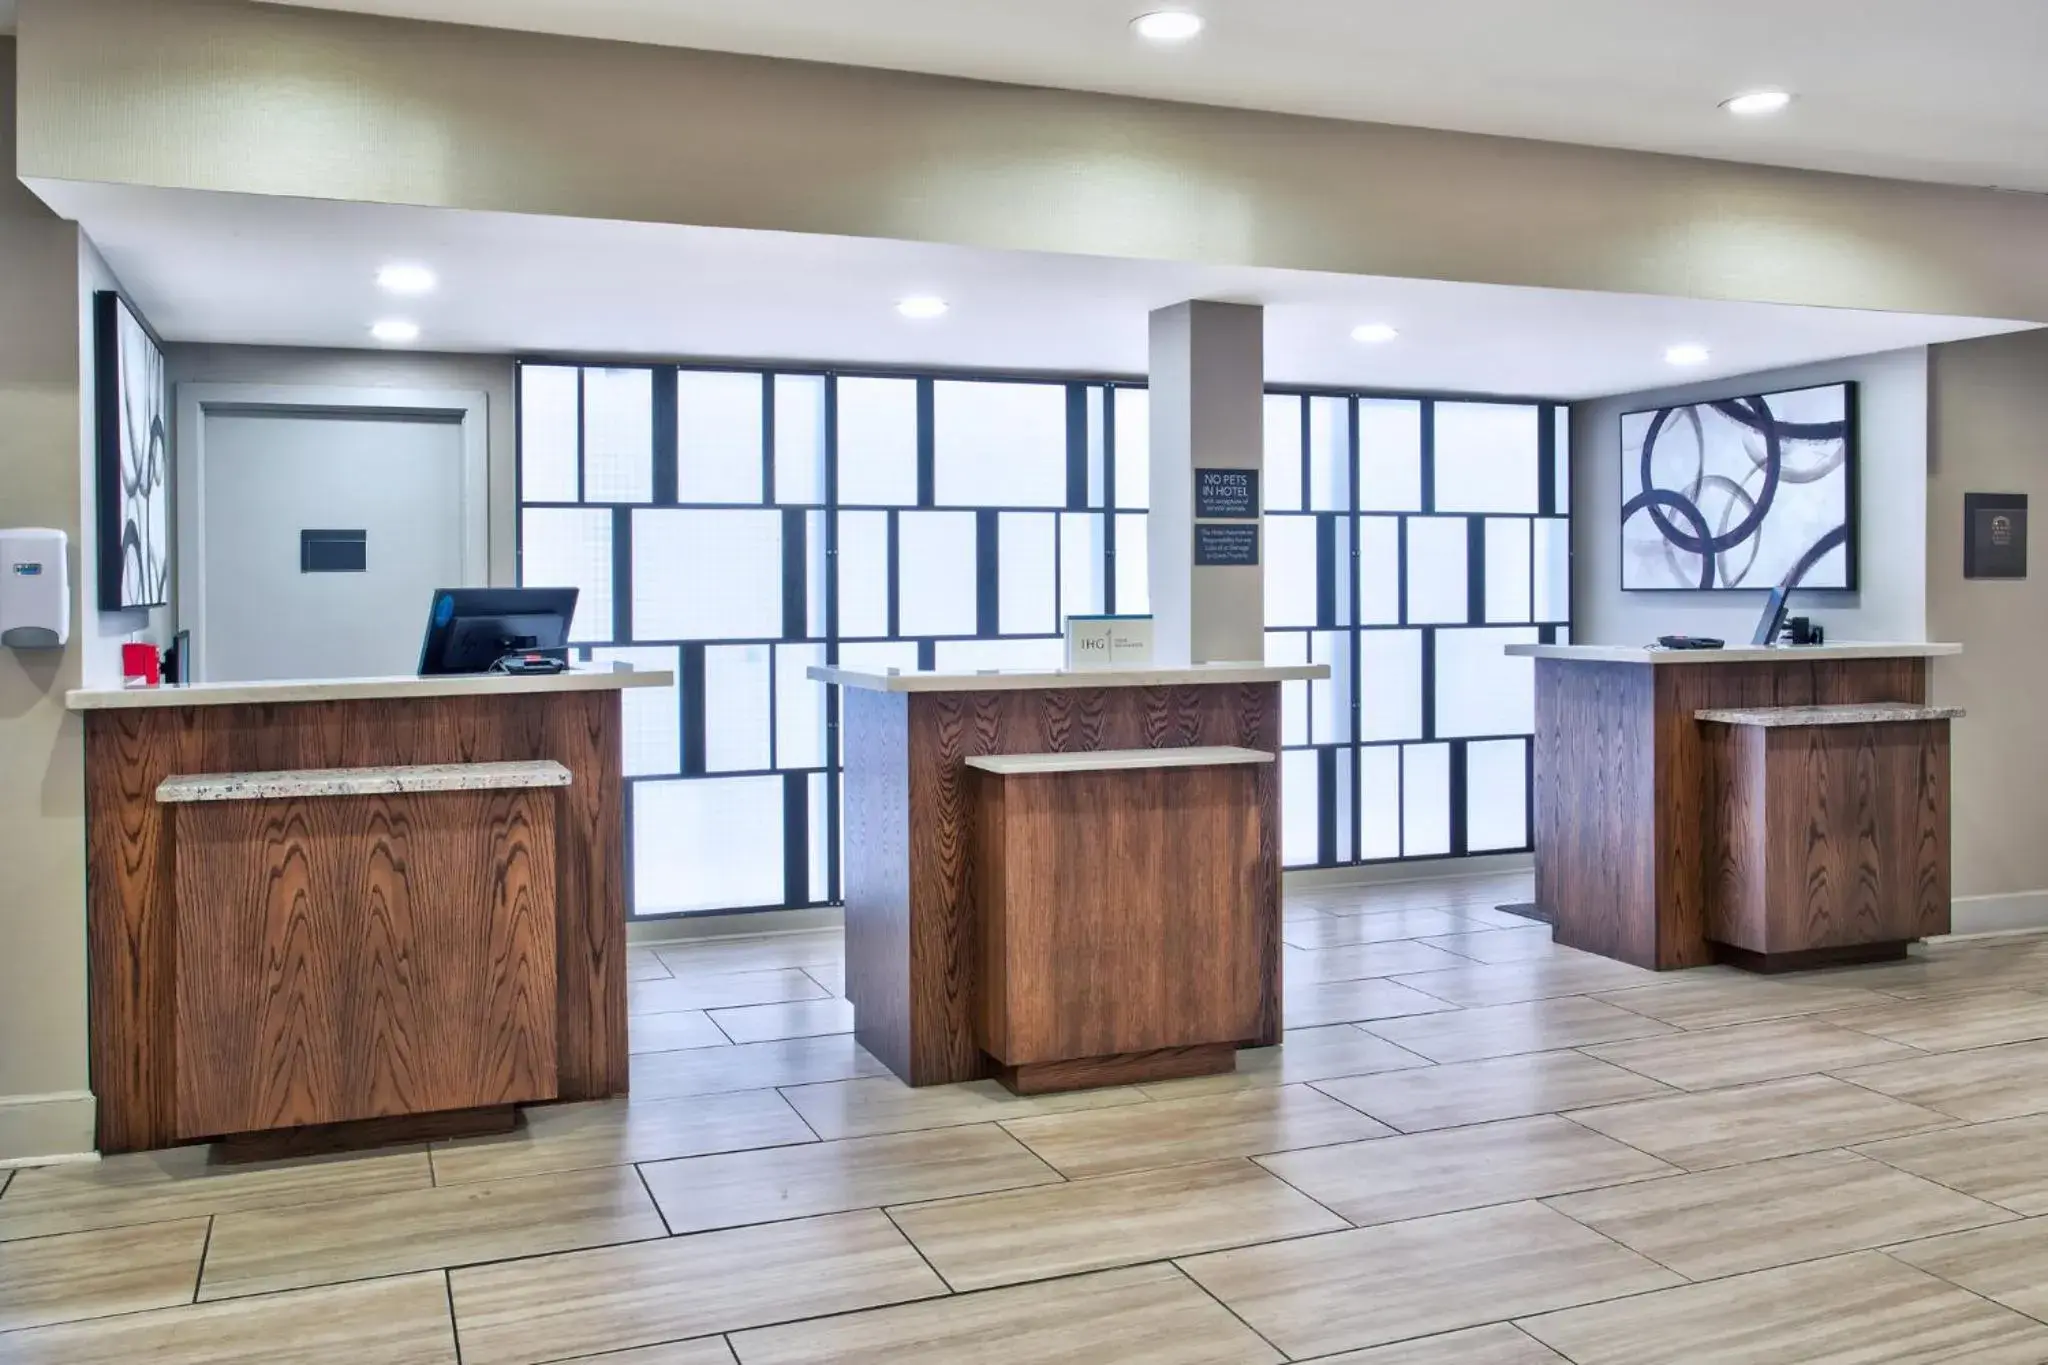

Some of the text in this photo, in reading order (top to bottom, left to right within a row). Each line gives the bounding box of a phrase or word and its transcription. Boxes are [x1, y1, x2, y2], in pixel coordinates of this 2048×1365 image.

[1204, 474, 1248, 486] NO PETS
[1202, 485, 1248, 497] IN HOTEL
[1081, 638, 1104, 650] IHG
